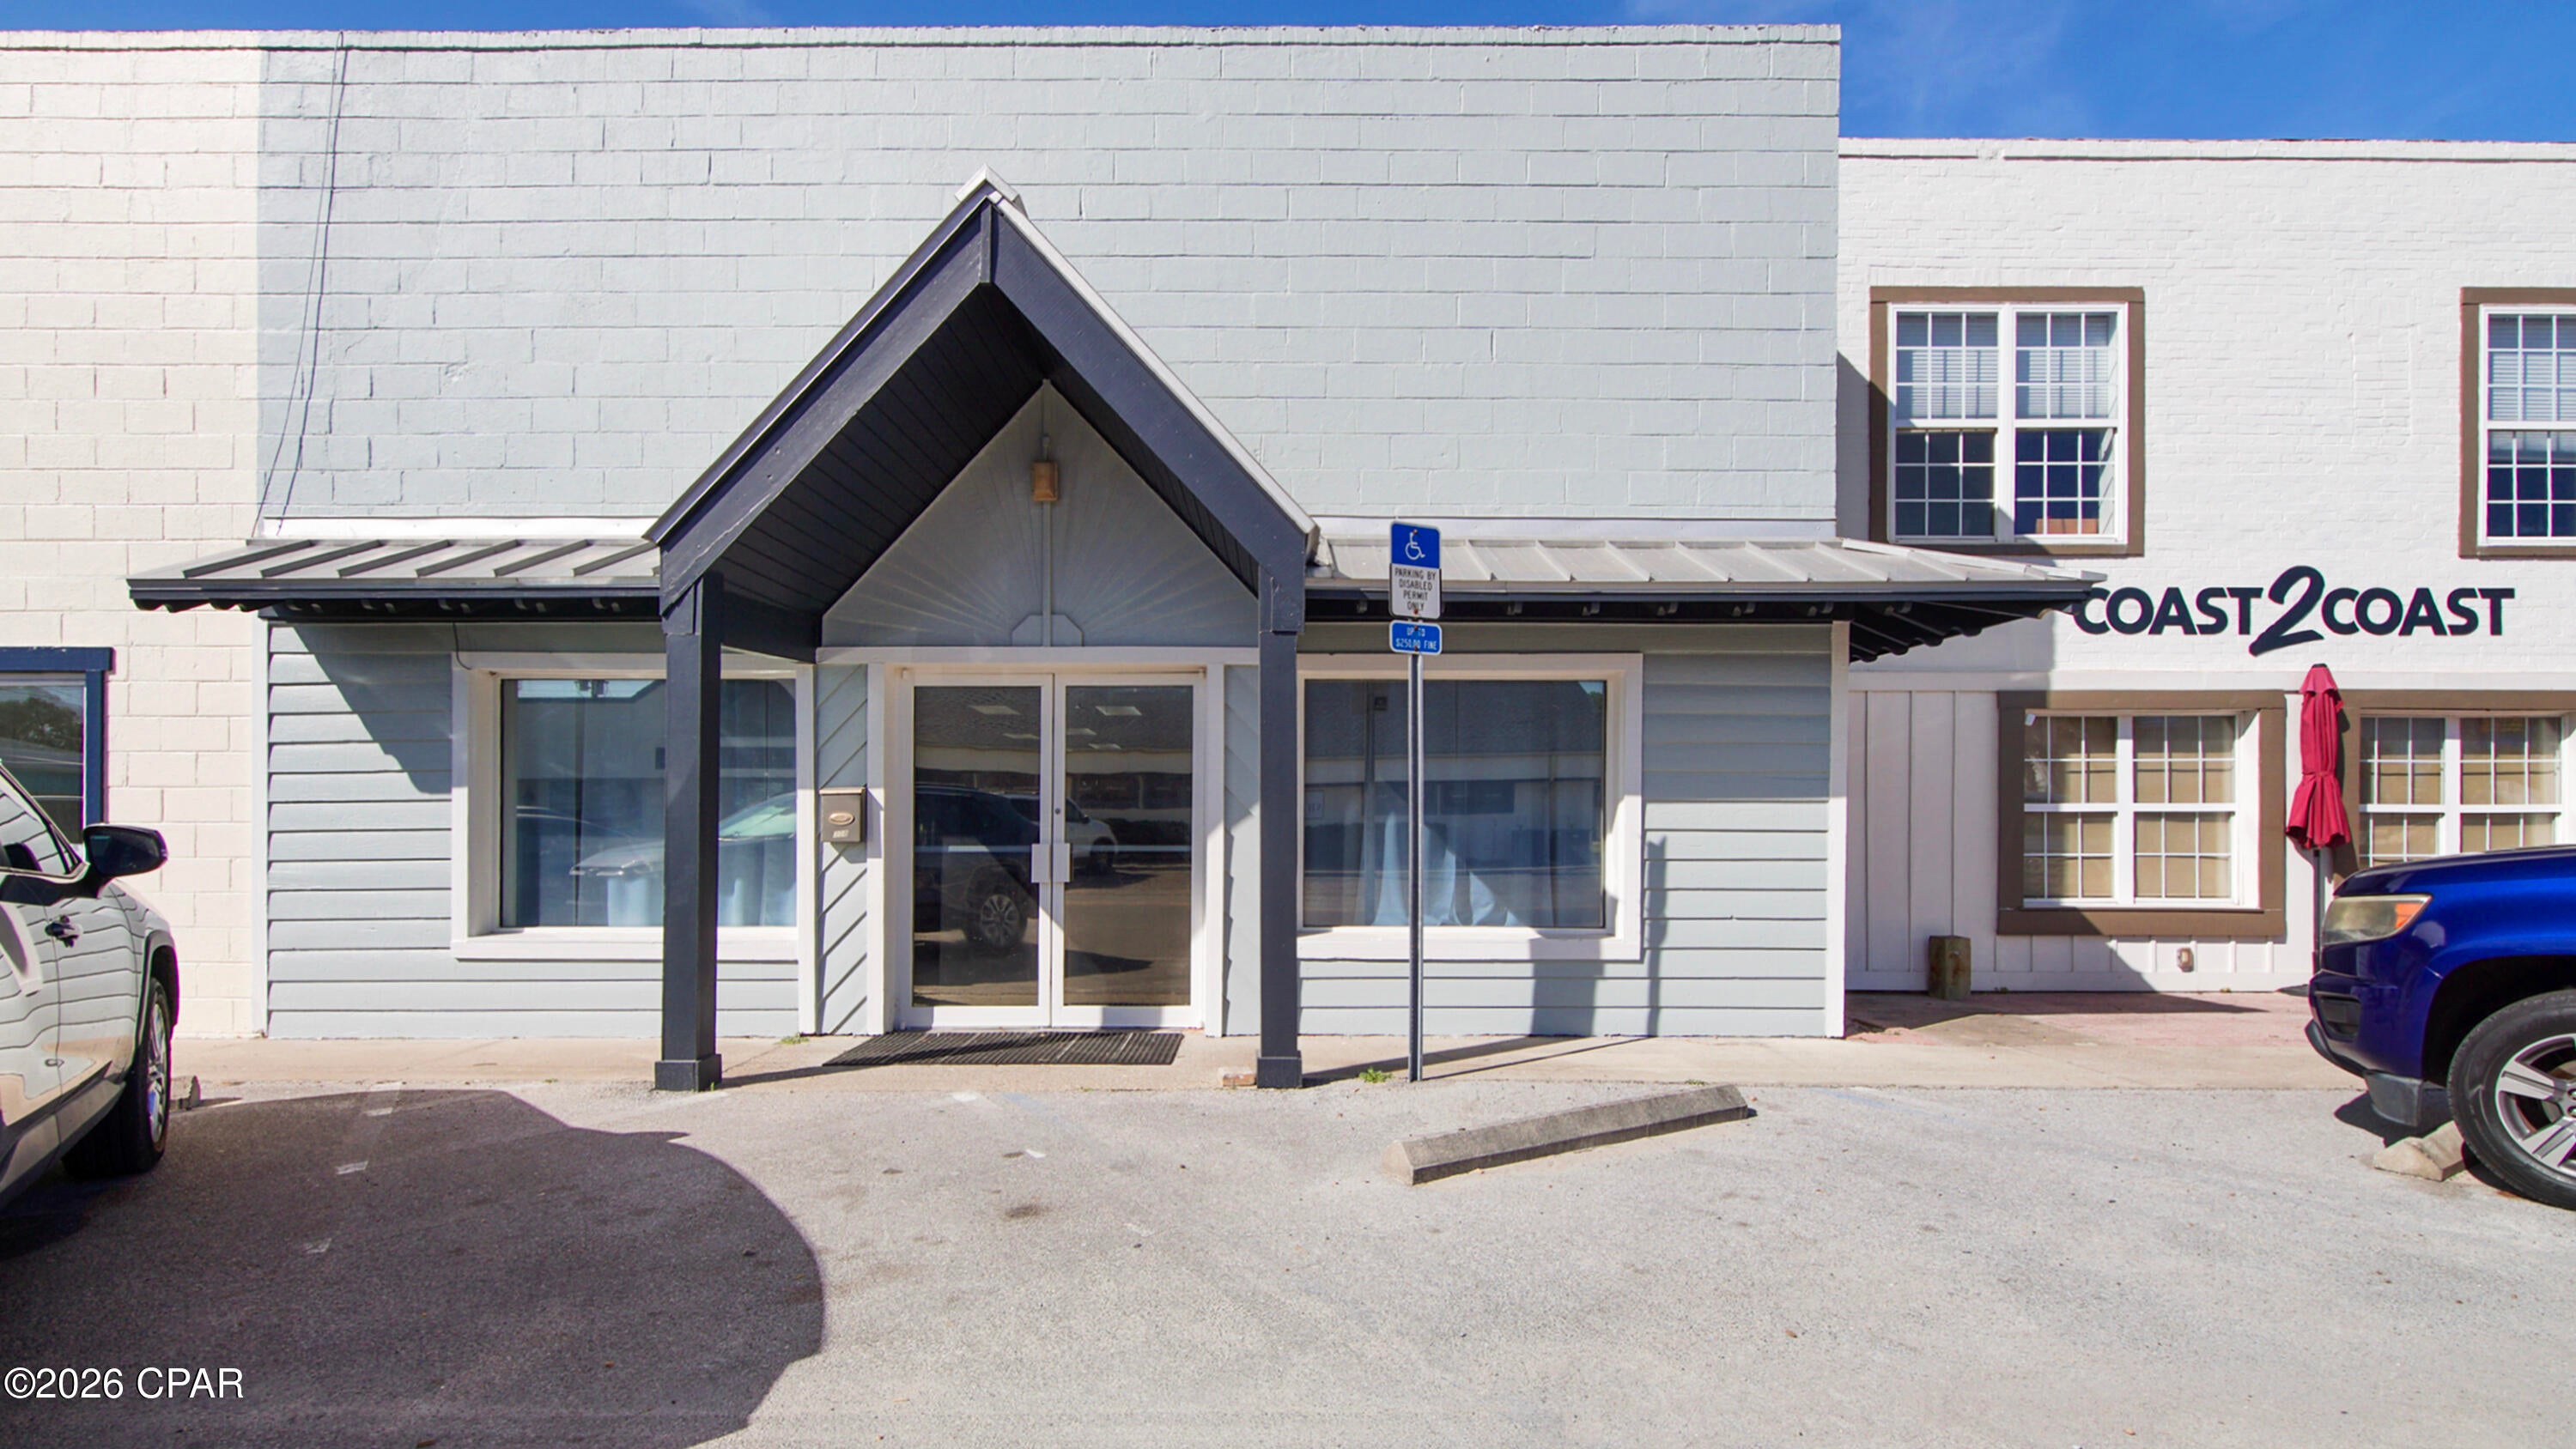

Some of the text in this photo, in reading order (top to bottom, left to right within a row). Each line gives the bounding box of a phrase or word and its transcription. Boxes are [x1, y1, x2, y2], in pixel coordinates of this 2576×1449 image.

[1394, 567, 1437, 580] PARKING BY
[1399, 579, 1433, 591] DISABLED
[1403, 590, 1428, 601] PERMIT
[1406, 601, 1425, 611] ONLY
[1406, 627, 1414, 636] UP
[1424, 640, 1437, 651] FINE
